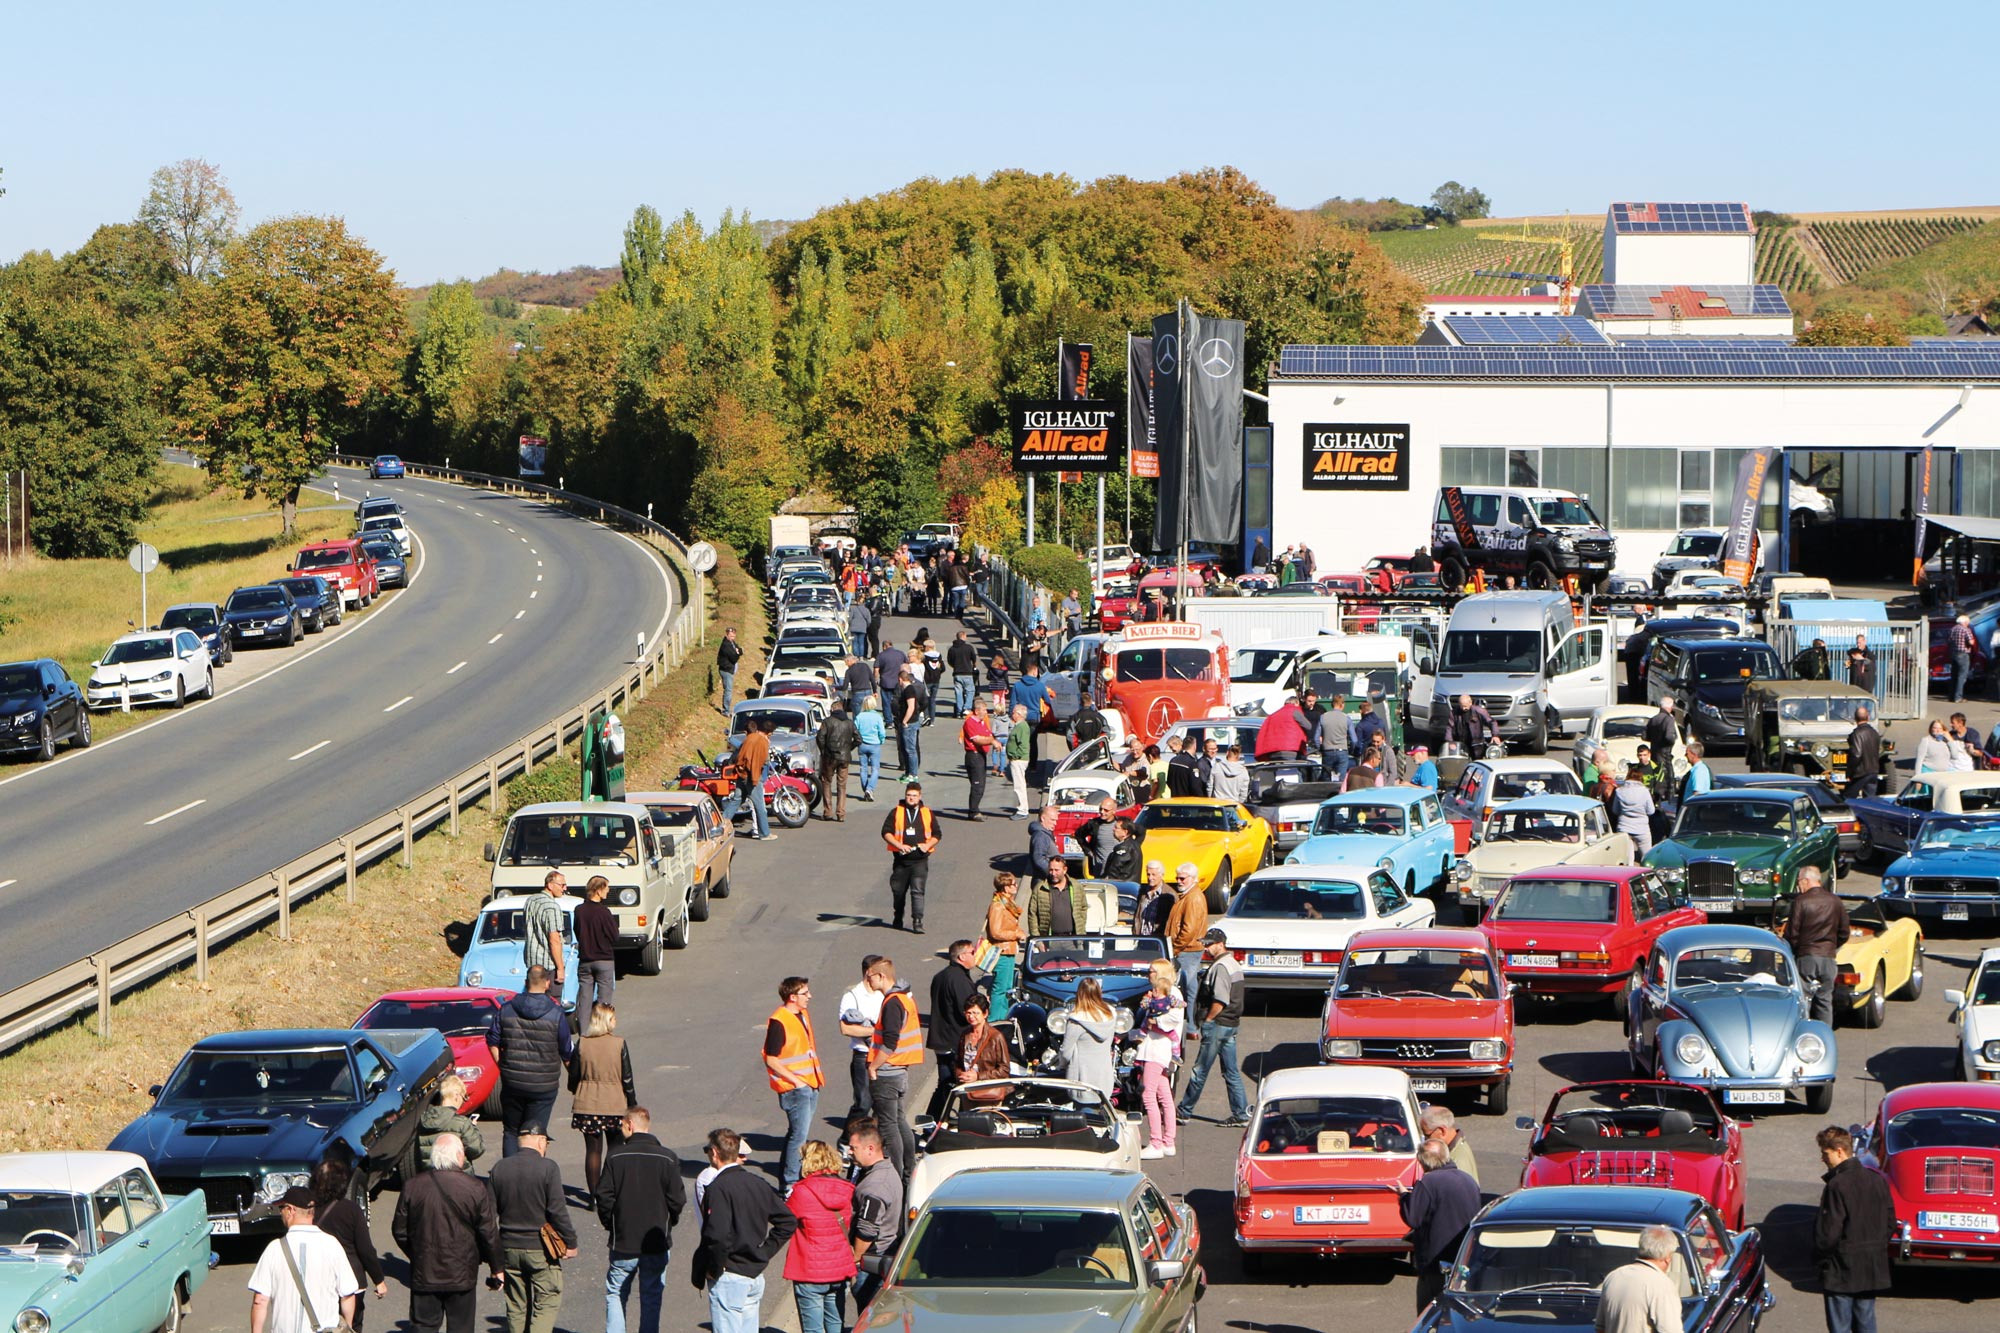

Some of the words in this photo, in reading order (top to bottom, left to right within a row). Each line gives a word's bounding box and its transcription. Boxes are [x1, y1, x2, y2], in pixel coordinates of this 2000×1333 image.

[1075, 351, 1089, 397] Allrad
[1021, 430, 1108, 452] Allrad
[1313, 452, 1397, 473] Allrad
[1746, 452, 1767, 500] Allrad
[1446, 487, 1476, 546] IGLHAUT
[1485, 536, 1528, 550] Allrad
[693, 550, 711, 565] 70
[1130, 626, 1168, 637] KAUZEN
[1172, 626, 1196, 636] BIER
[1277, 957, 1299, 965] 478H
[1425, 1080, 1446, 1090] 73H
[1752, 1092, 1766, 1102] BJ
[1769, 1092, 1782, 1102] 58
[1306, 1208, 1322, 1220] KT
[1332, 1208, 1363, 1220] 0734
[1960, 1215, 1989, 1228] 356H
